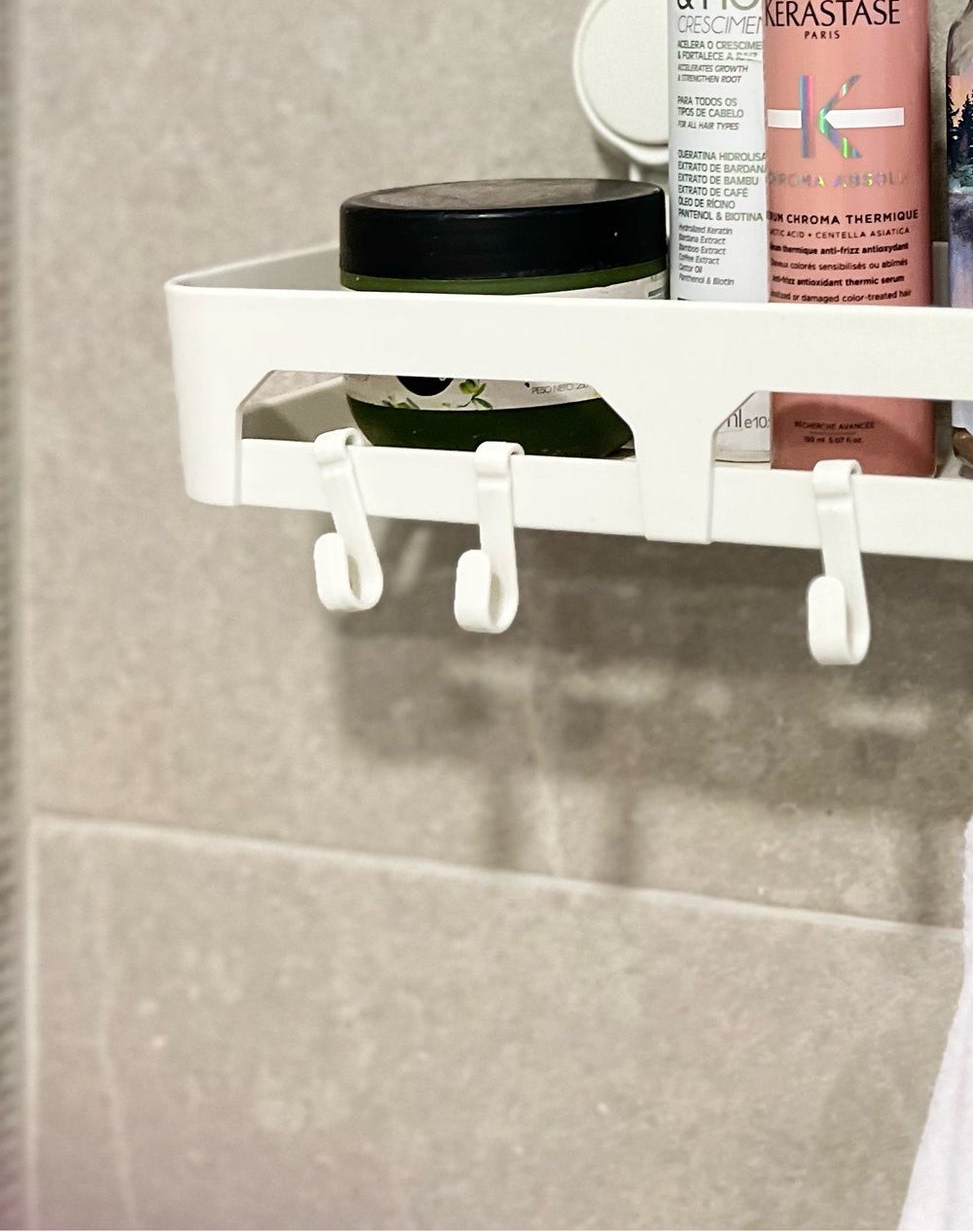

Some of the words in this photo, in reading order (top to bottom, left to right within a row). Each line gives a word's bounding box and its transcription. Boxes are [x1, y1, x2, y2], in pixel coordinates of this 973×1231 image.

[804, 30, 841, 40] PARIS
[706, 40, 714, 50] O
[715, 64, 749, 73] GROWTH
[720, 75, 743, 83] ROOT
[677, 95, 693, 106] PARA
[694, 97, 723, 107] TODOS
[724, 97, 738, 107] OS
[677, 106, 695, 117] TIPOS
[695, 108, 706, 118] DE
[708, 109, 744, 119] CABELO
[687, 121, 697, 129] ALL
[698, 122, 715, 130] HAIR
[677, 161, 708, 172] EXTRATO
[709, 163, 721, 173] DE
[677, 173, 708, 184] EXTRATO
[709, 175, 721, 185] DE
[723, 176, 759, 186] BAMBU
[677, 185, 708, 196] EXTRATO
[709, 187, 721, 197] DE
[723, 187, 749, 198] CAFÉ
[694, 198, 704, 208] DE
[677, 208, 714, 221] PANTENOL
[715, 211, 722, 221] &
[724, 212, 764, 222] BIOTINA
[786, 213, 841, 225] CHROMA
[845, 209, 919, 225] THERMIQUE
[786, 230, 805, 239] ACID
[815, 231, 867, 239] CENTELLA
[870, 227, 911, 237] ASIATICA
[699, 235, 726, 245] Extract
[700, 246, 727, 256] Extract
[820, 246, 860, 255] anti-frizz
[861, 242, 910, 255] antioxydant
[695, 255, 720, 265] Extract
[868, 262, 880, 270] ou
[797, 277, 843, 287] antioxidant
[845, 275, 879, 286] thermic
[881, 274, 905, 284] serum
[801, 293, 840, 304] damaged
[842, 291, 898, 303] color-treated
[898, 289, 912, 299] hair
